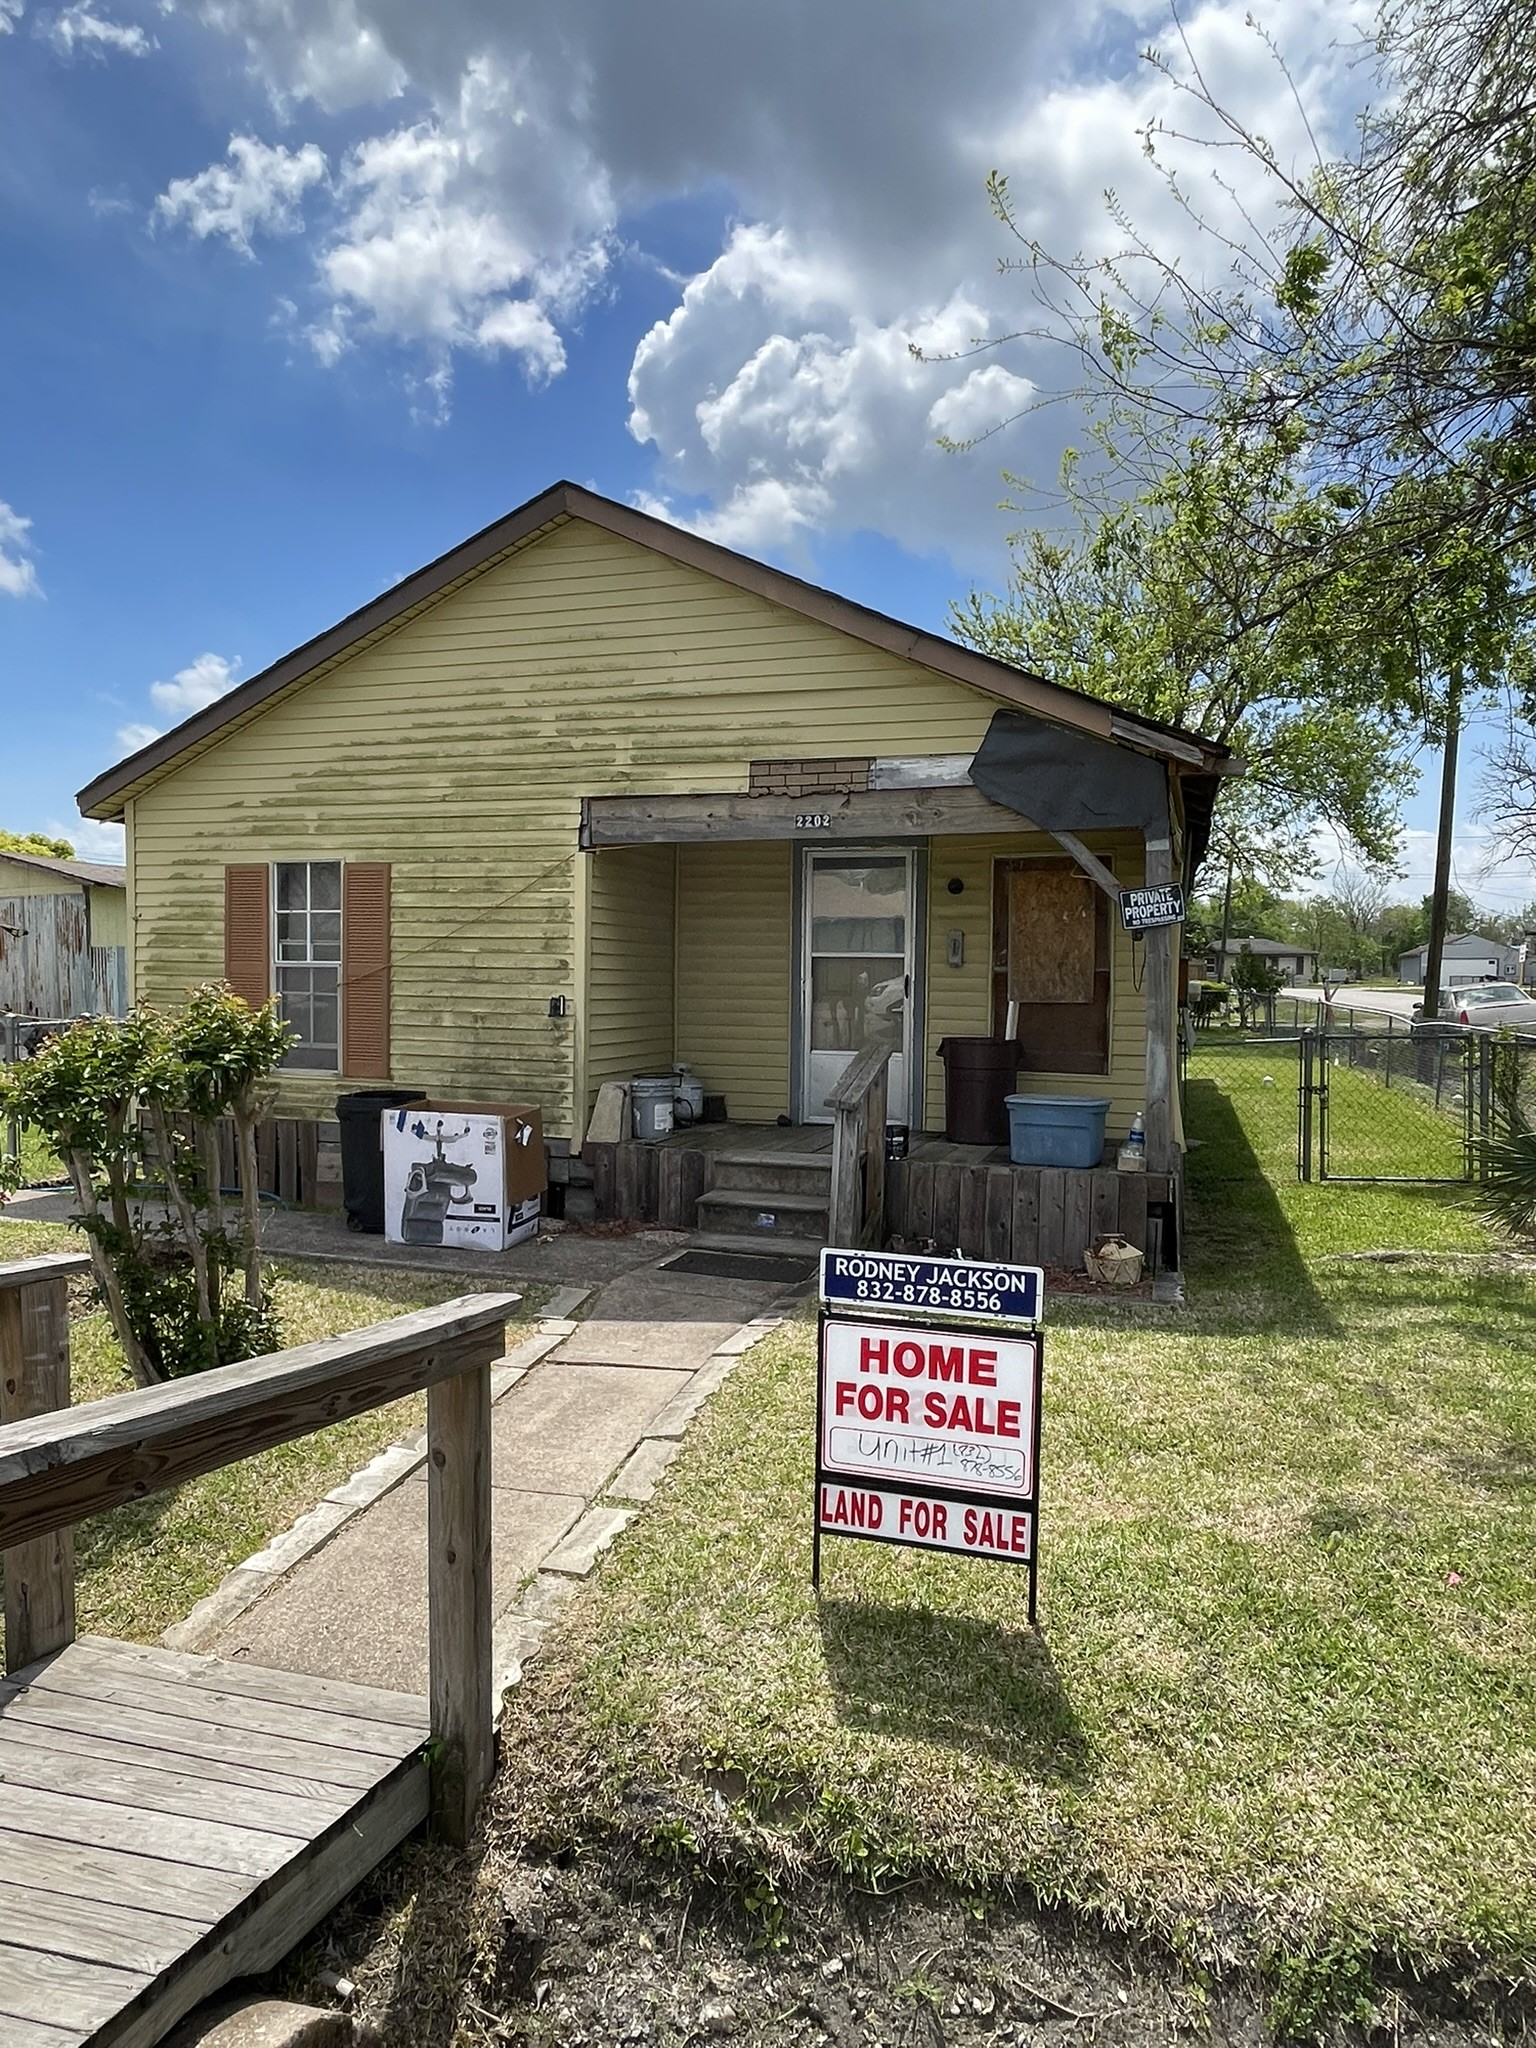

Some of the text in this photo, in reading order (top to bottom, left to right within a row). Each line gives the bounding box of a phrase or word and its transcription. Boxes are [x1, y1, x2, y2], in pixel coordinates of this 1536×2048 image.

[796, 814, 830, 827] 2202
[1125, 900, 1180, 920] PROPERTY
[1130, 887, 1173, 906] PRIVATE
[835, 1258, 1026, 1293] RODNEY JACKSON
[856, 1280, 1002, 1311] 832-878-8556
[859, 1337, 998, 1387] HOME
[835, 1381, 1021, 1438] FOR SALE
[960, 1458, 1022, 1481] 878-8556
[821, 1487, 1027, 1553] LAND FOR SALE
